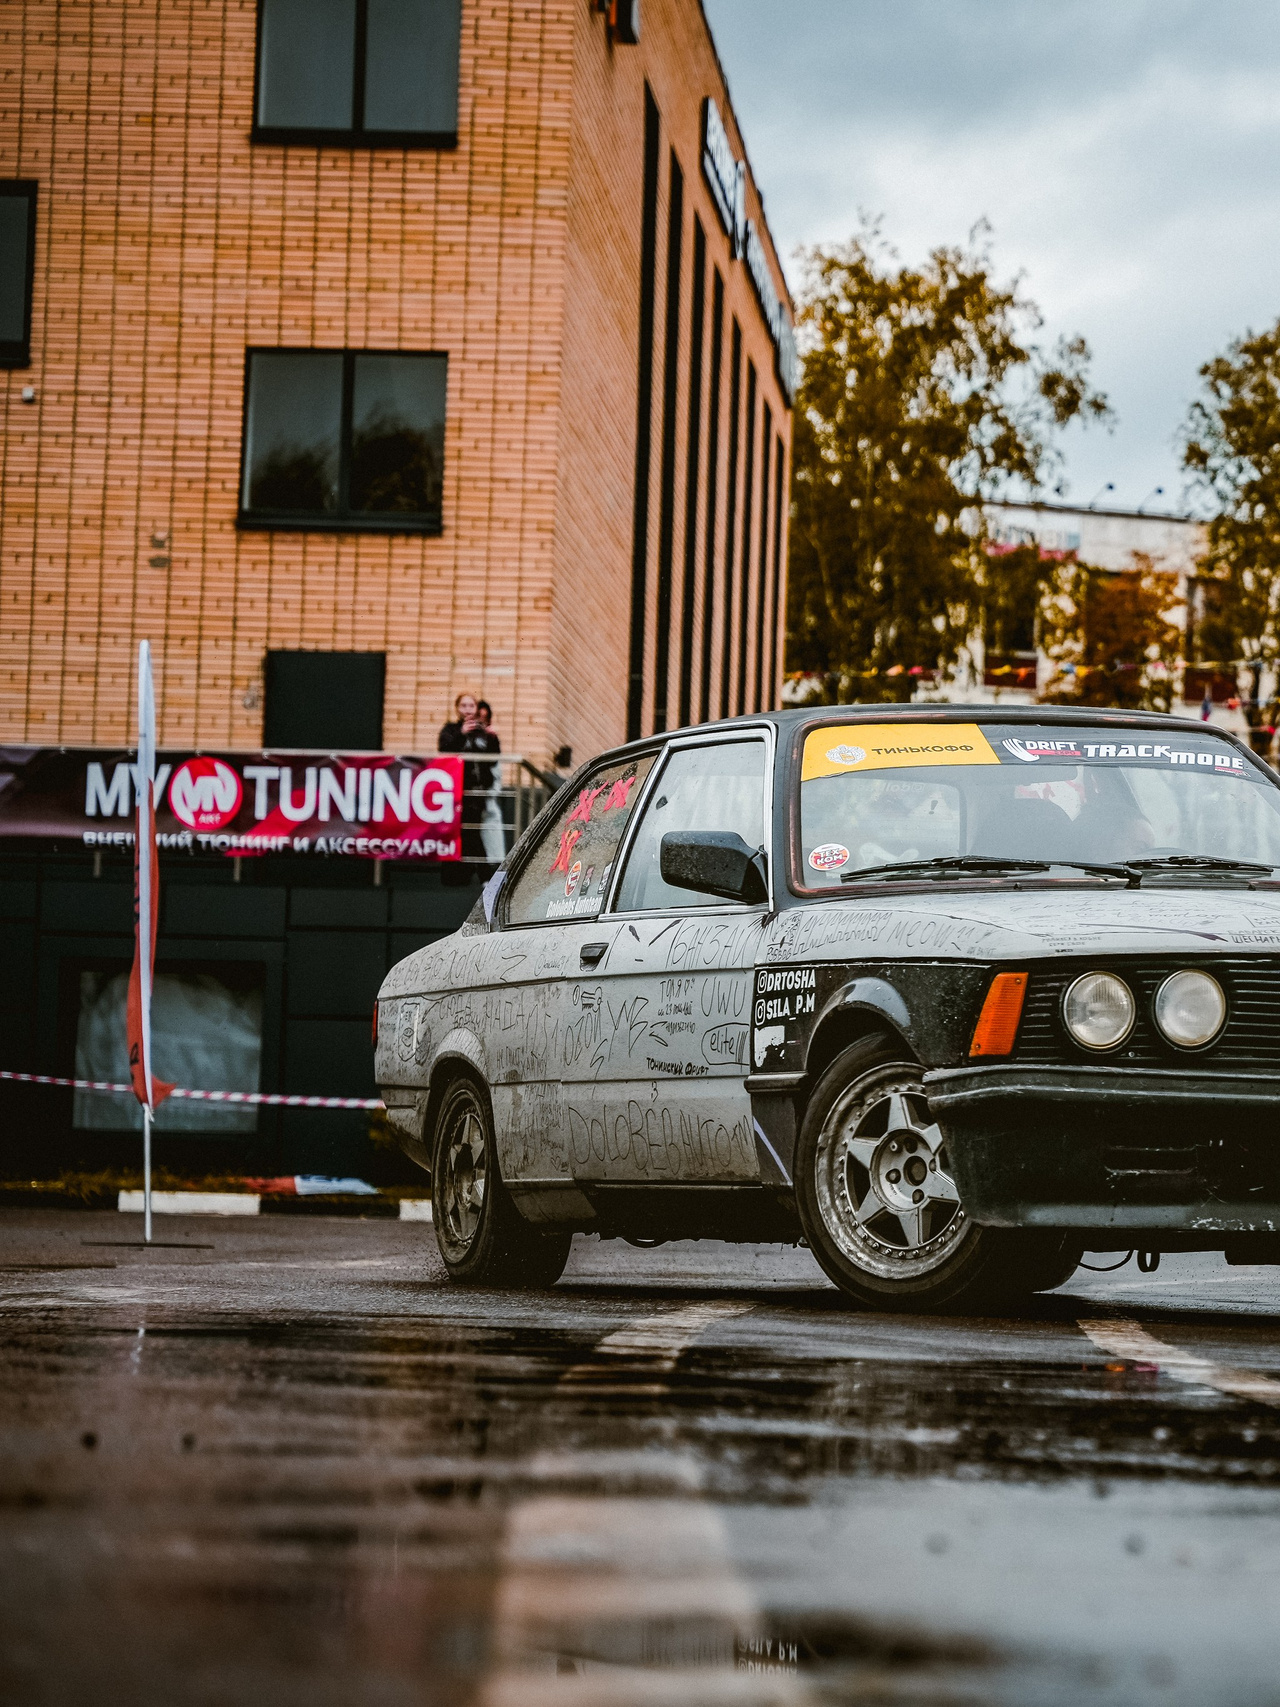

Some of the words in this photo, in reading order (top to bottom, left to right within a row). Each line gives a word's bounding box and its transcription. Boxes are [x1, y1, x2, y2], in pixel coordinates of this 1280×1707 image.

[872, 742, 974, 755] ТИНЬКОФФ
[1026, 741, 1077, 751] DRIFT
[243, 765, 455, 824] TUNING
[196, 833, 291, 851] ТЮНИНГ
[293, 836, 310, 853] И
[315, 837, 456, 856] АКСЕССУАРЫ
[766, 969, 816, 992] DRTOSHA
[766, 993, 815, 1021] SILA_P.M
